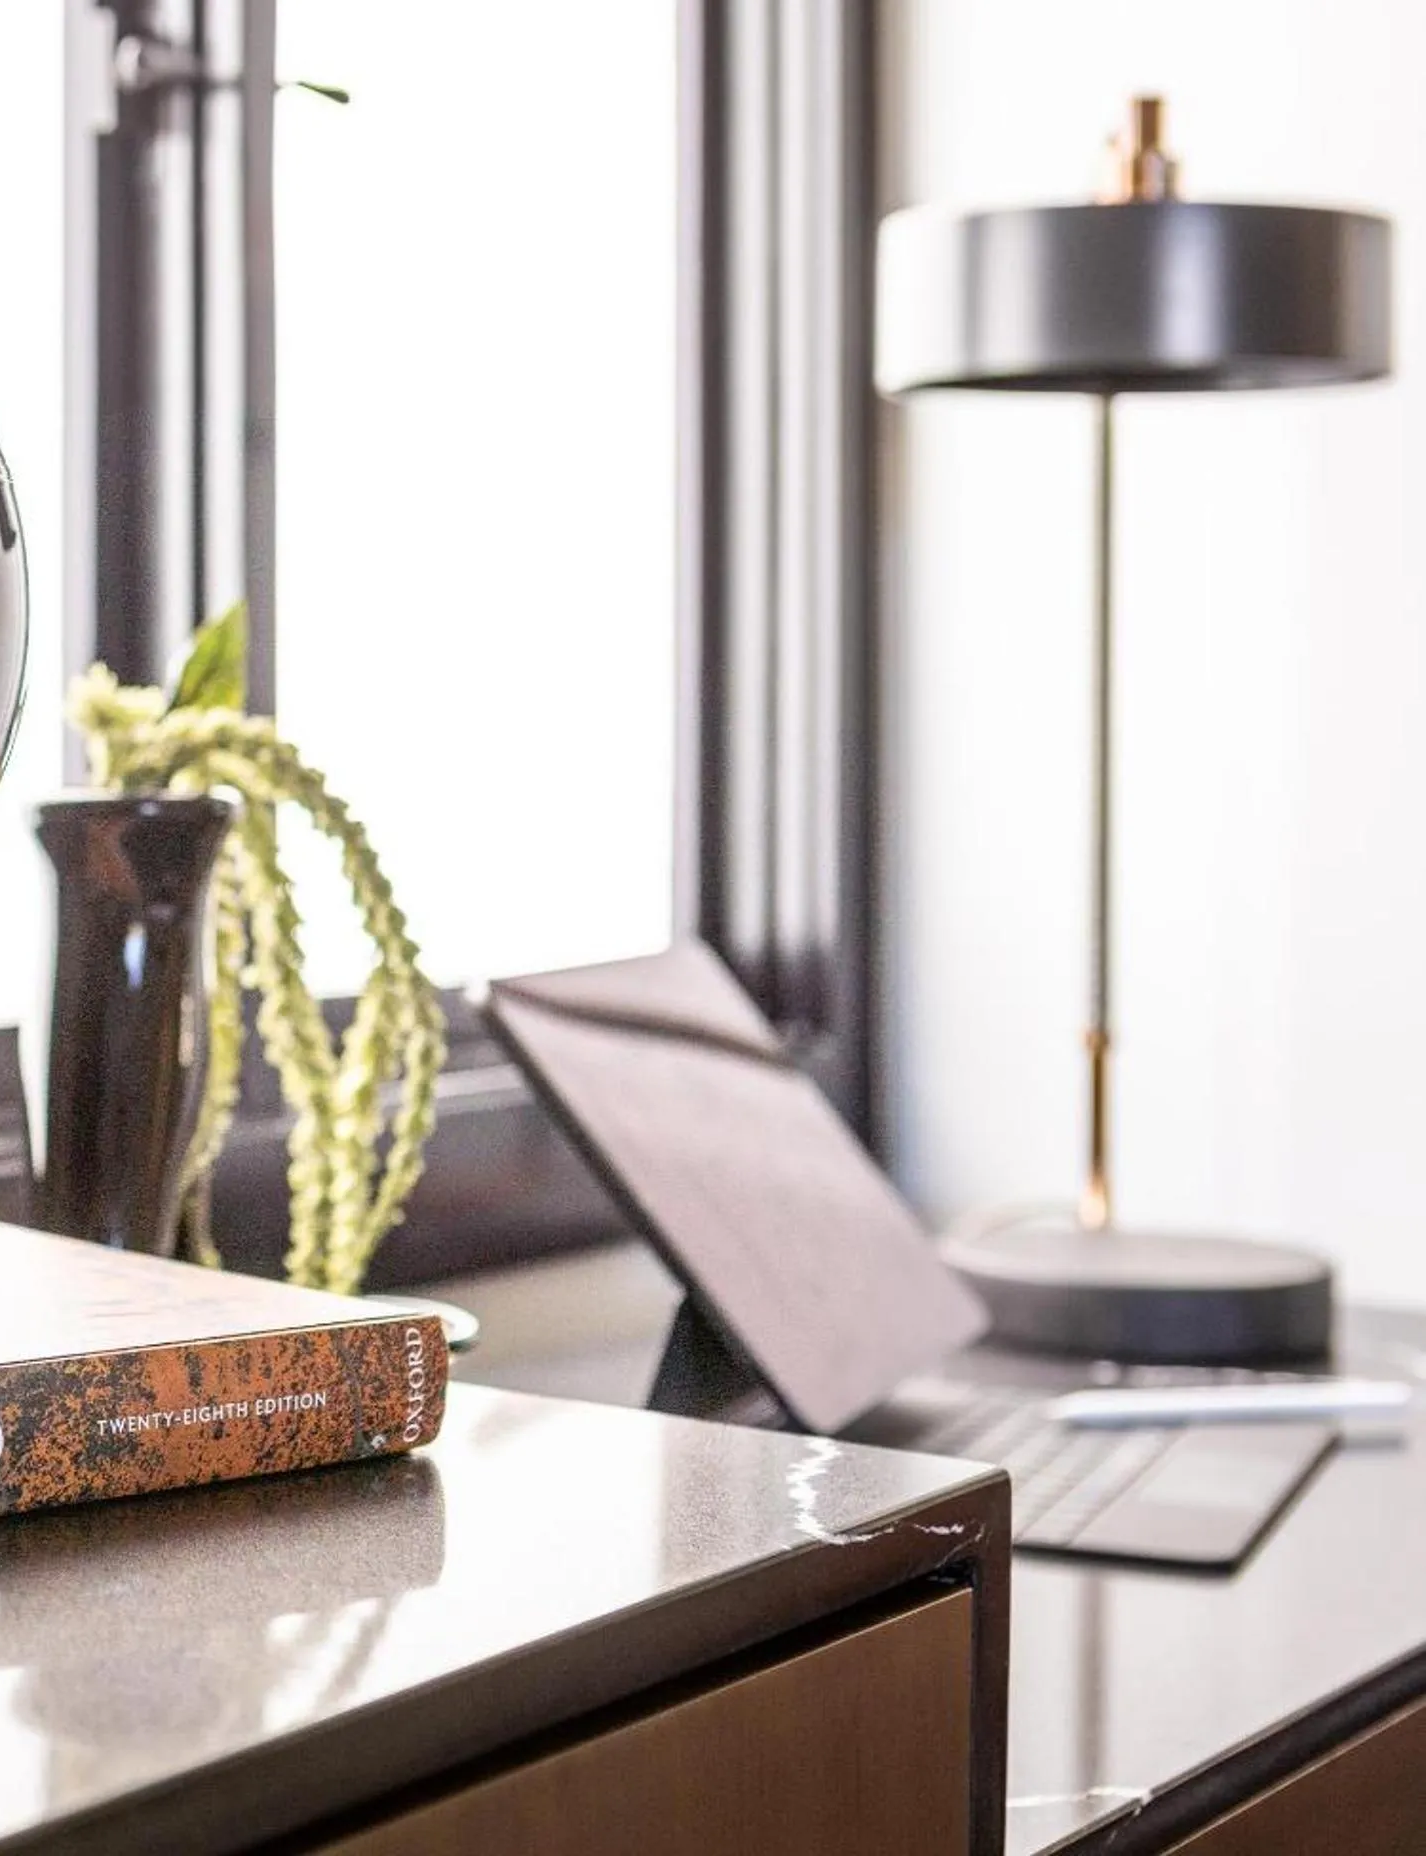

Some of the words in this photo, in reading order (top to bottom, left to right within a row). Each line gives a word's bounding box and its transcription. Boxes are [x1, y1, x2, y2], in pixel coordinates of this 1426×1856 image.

[96, 1401, 249, 1437] TWENTY-EIGHTH
[255, 1391, 327, 1416] EDITION
[402, 1326, 426, 1444] OXFORD
